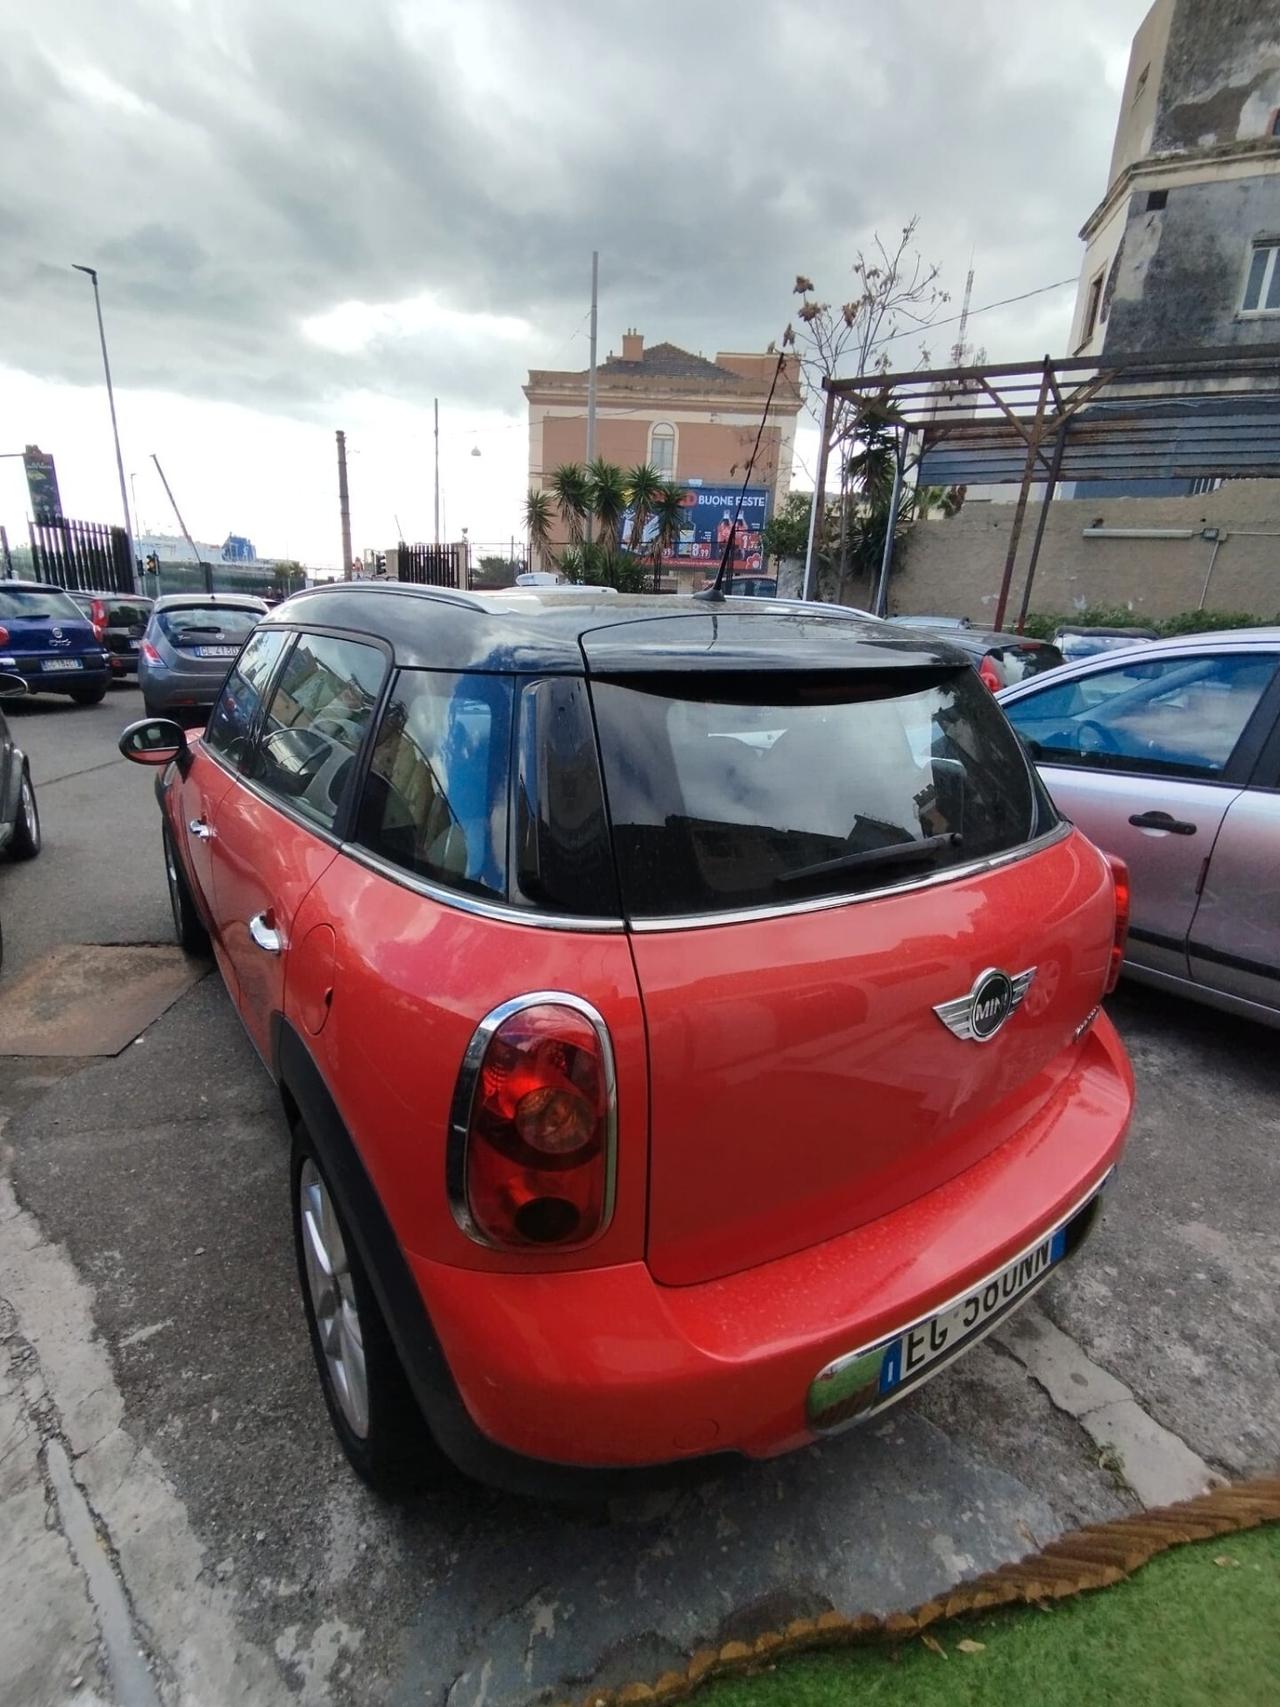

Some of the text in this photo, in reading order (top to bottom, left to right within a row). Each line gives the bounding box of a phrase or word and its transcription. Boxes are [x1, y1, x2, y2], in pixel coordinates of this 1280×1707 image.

[698, 495, 733, 506] BUONE
[735, 496, 765, 507] FESTE
[975, 993, 1008, 1021] MINI
[906, 1319, 948, 1372] EG
